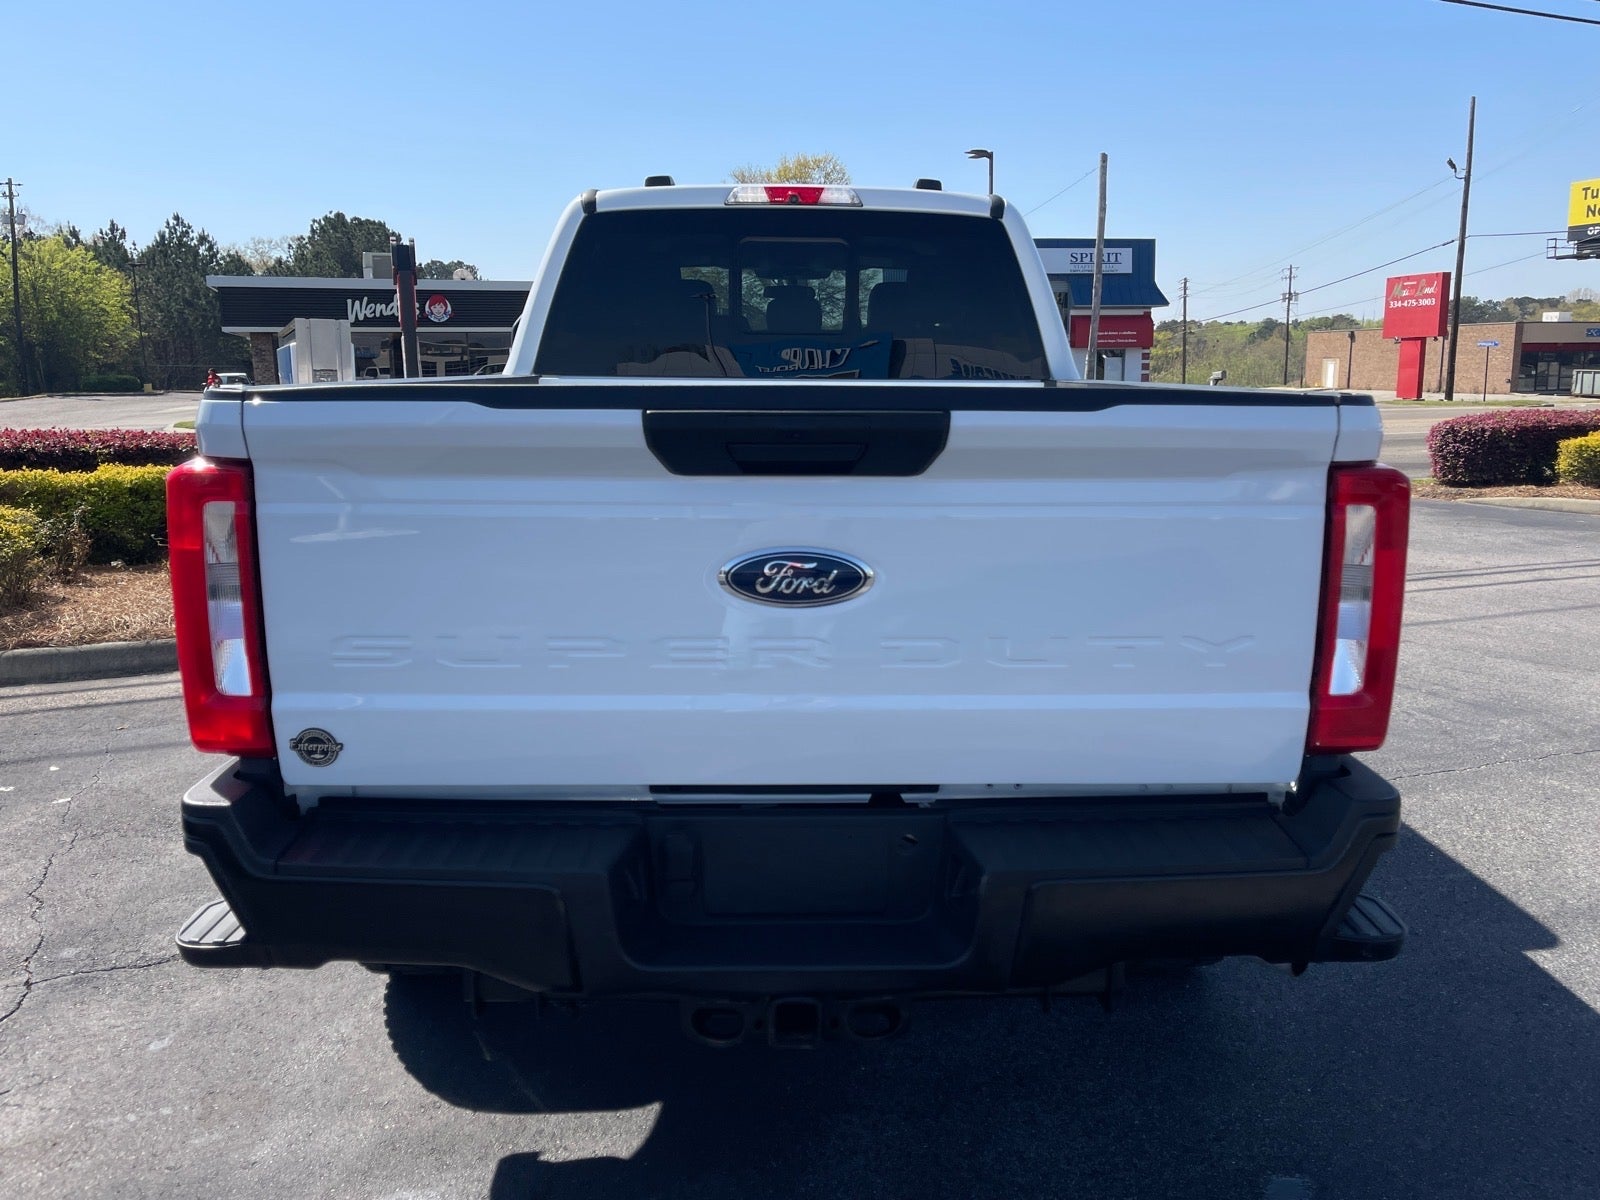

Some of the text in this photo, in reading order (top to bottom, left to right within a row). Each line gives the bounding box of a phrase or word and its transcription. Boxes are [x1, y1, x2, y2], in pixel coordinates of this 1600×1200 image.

[1586, 203, 1600, 218] N
[346, 293, 420, 323] Wends
[1389, 298, 1436, 309] 334-475-3003
[755, 560, 838, 594] Ford
[331, 634, 1256, 668] SUPER DUTY
